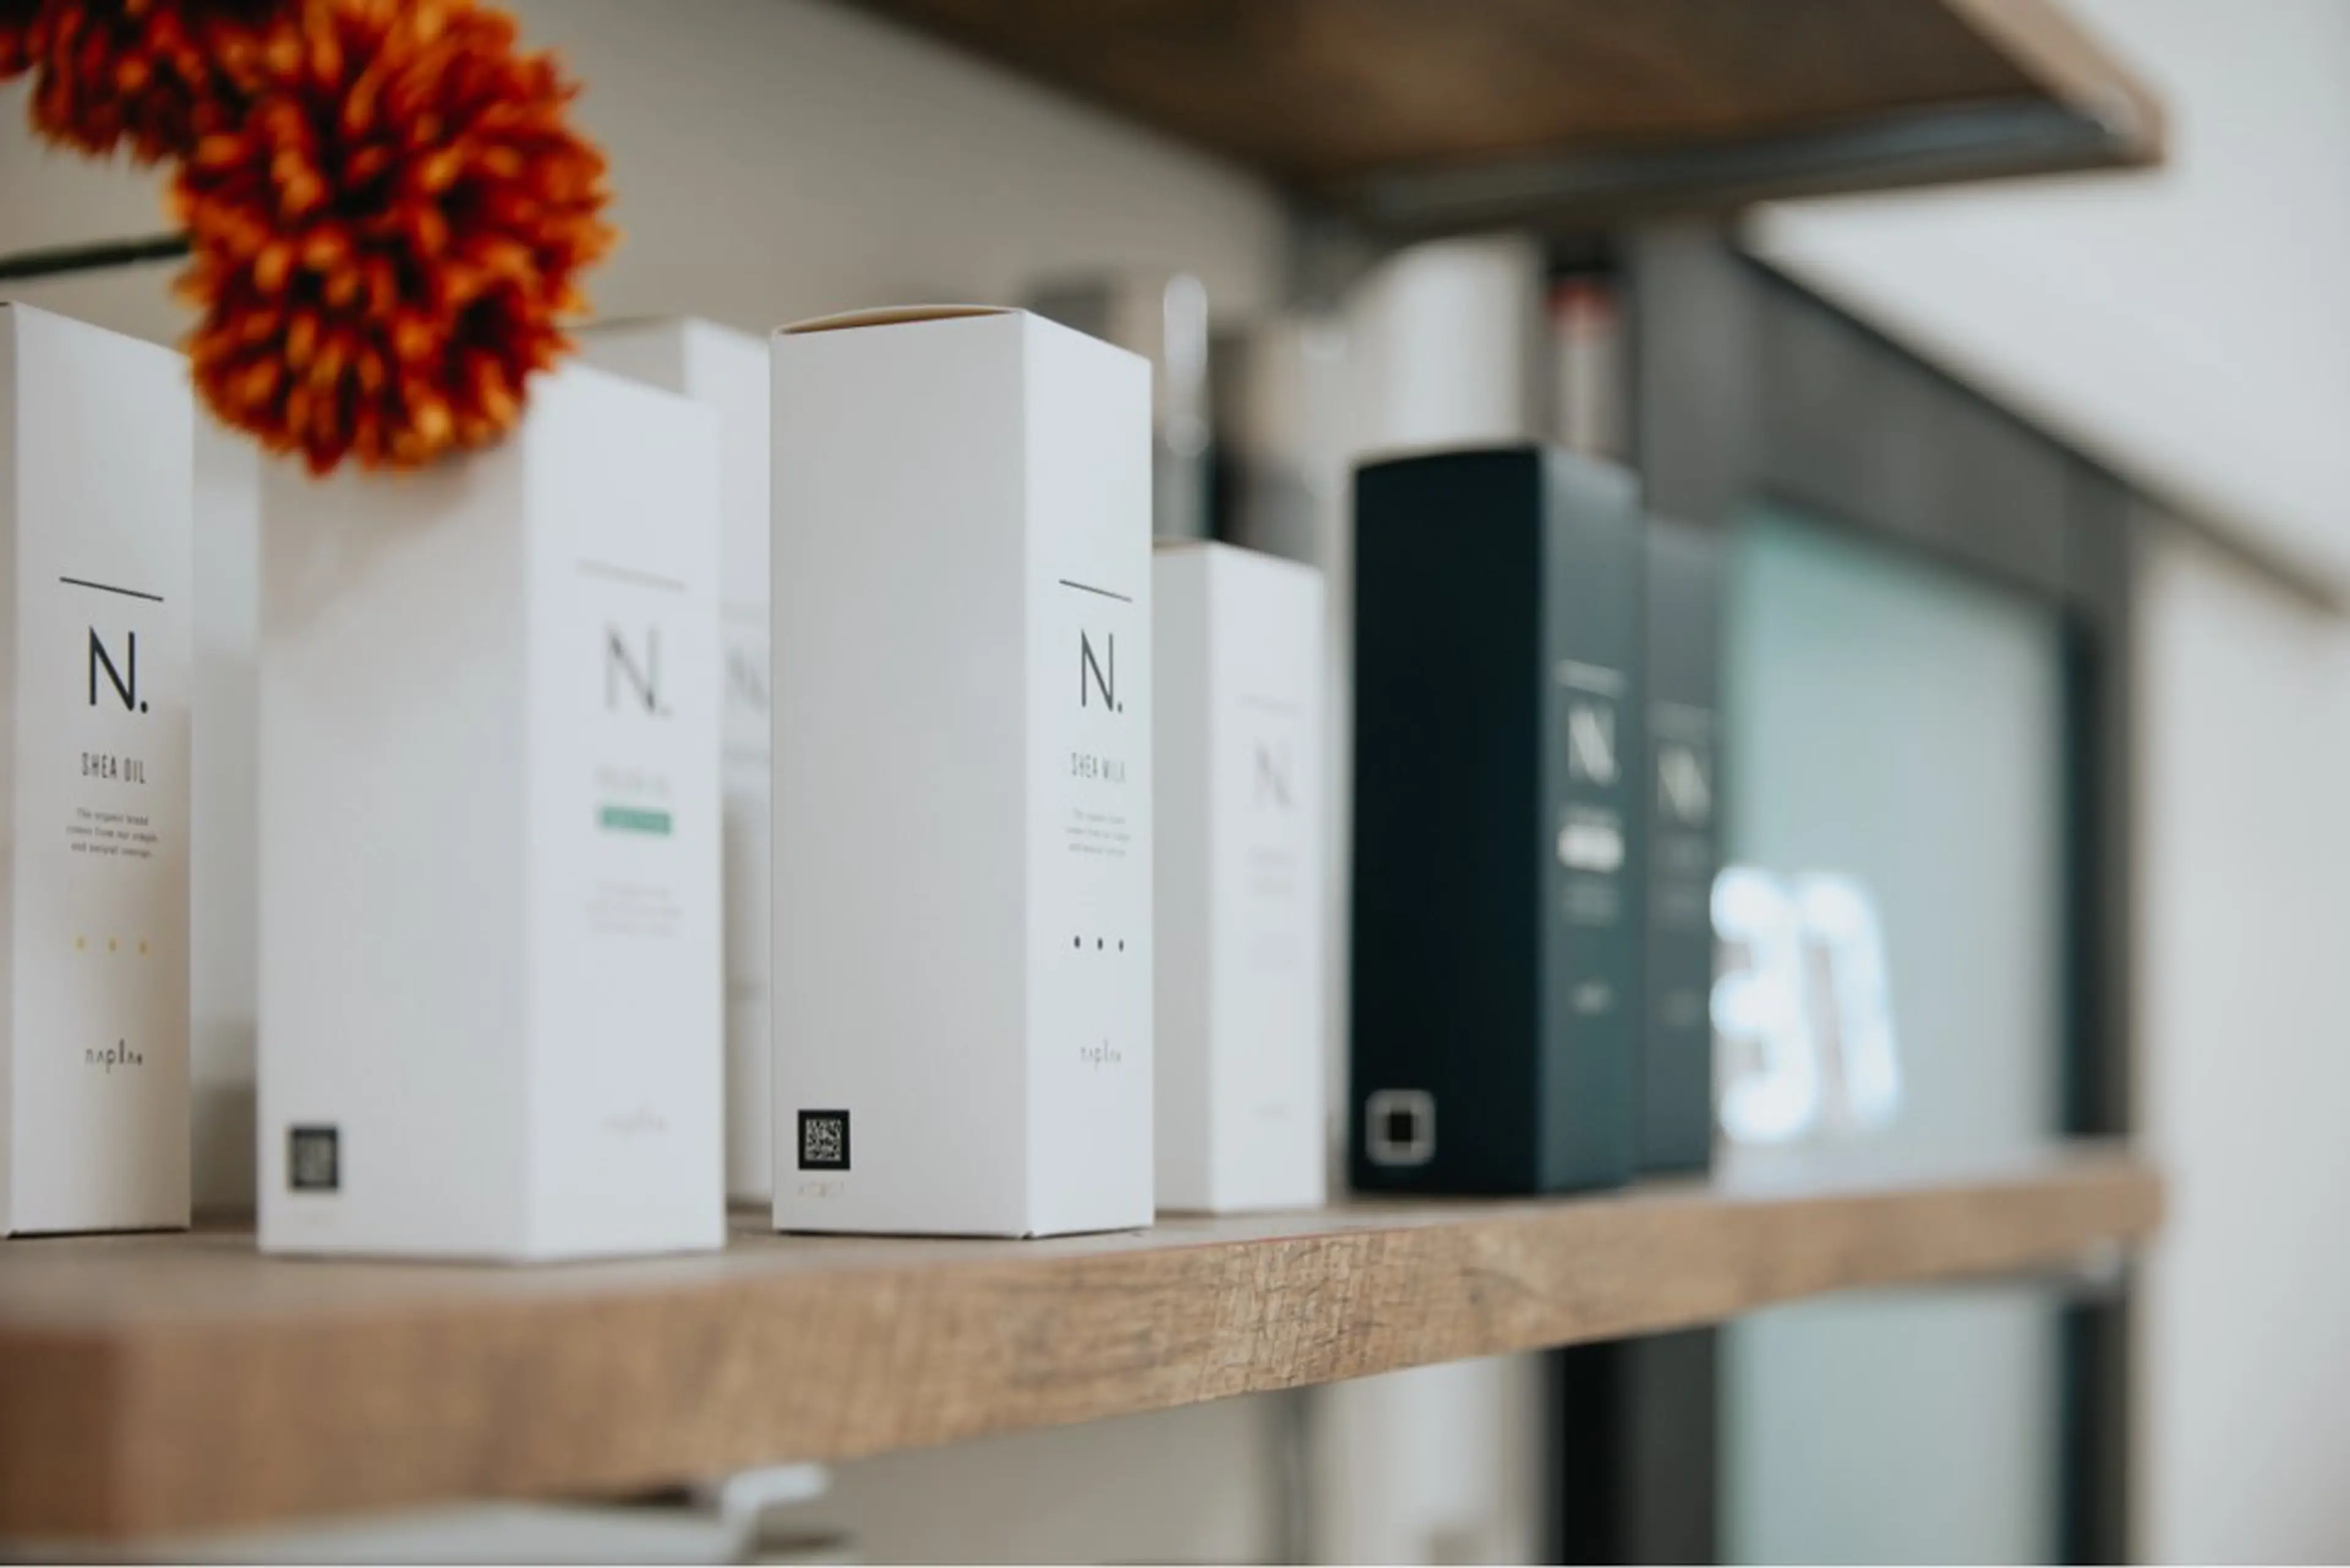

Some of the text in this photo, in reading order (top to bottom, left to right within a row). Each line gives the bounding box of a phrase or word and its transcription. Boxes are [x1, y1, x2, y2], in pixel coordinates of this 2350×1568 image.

[89, 624, 148, 714] N.
[1081, 628, 1122, 714] N.
[81, 752, 146, 785] SHEA OIL
